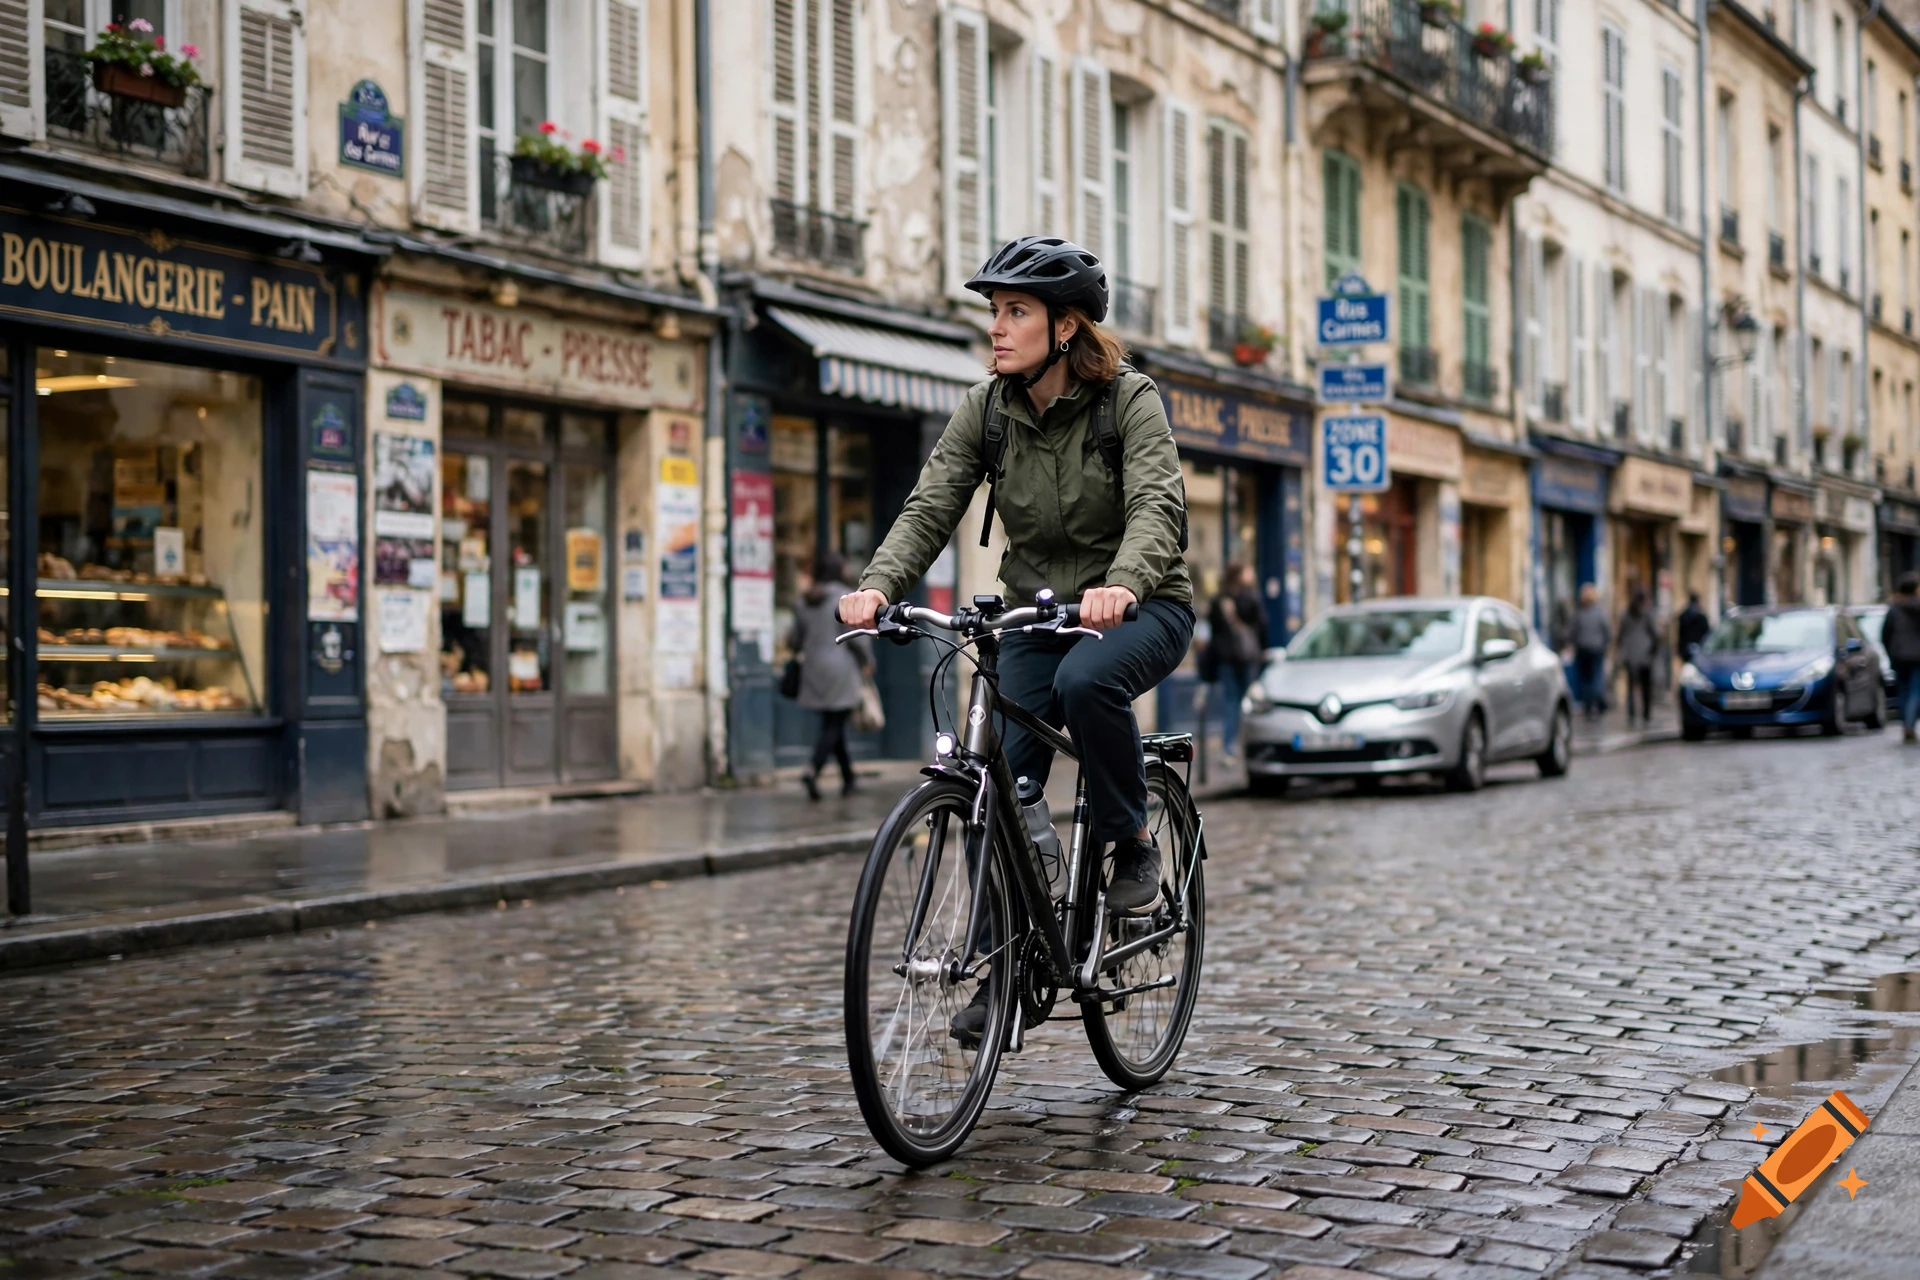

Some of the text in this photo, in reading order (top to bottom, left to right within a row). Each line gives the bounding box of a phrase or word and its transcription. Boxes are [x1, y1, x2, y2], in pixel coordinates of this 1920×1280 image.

[2, 232, 225, 320] BOULANGERIE
[251, 277, 316, 334] PAIN
[442, 307, 533, 370] TABAC
[561, 329, 653, 389] PRESSE
[1329, 445, 1381, 483] 30
